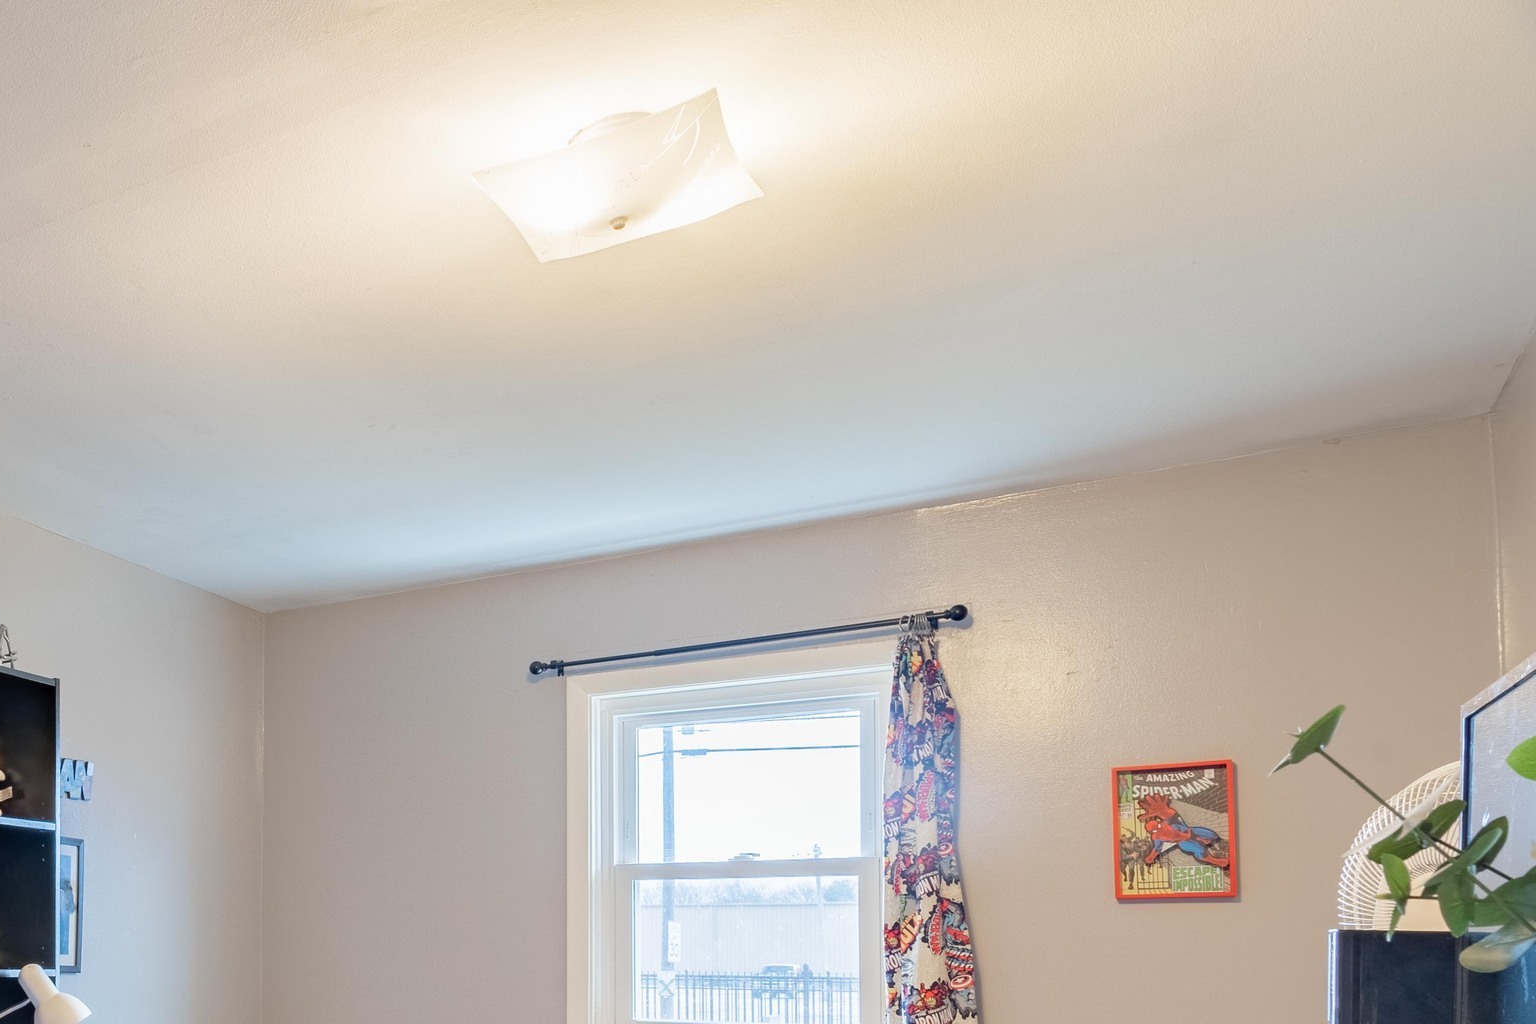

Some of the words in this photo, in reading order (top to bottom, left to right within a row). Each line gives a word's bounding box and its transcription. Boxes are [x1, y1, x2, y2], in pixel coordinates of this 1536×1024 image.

[1146, 770, 1195, 782] AMAZING
[1132, 777, 1215, 800] SPIDER-MAN
[1173, 867, 1217, 880] ESCAPE
